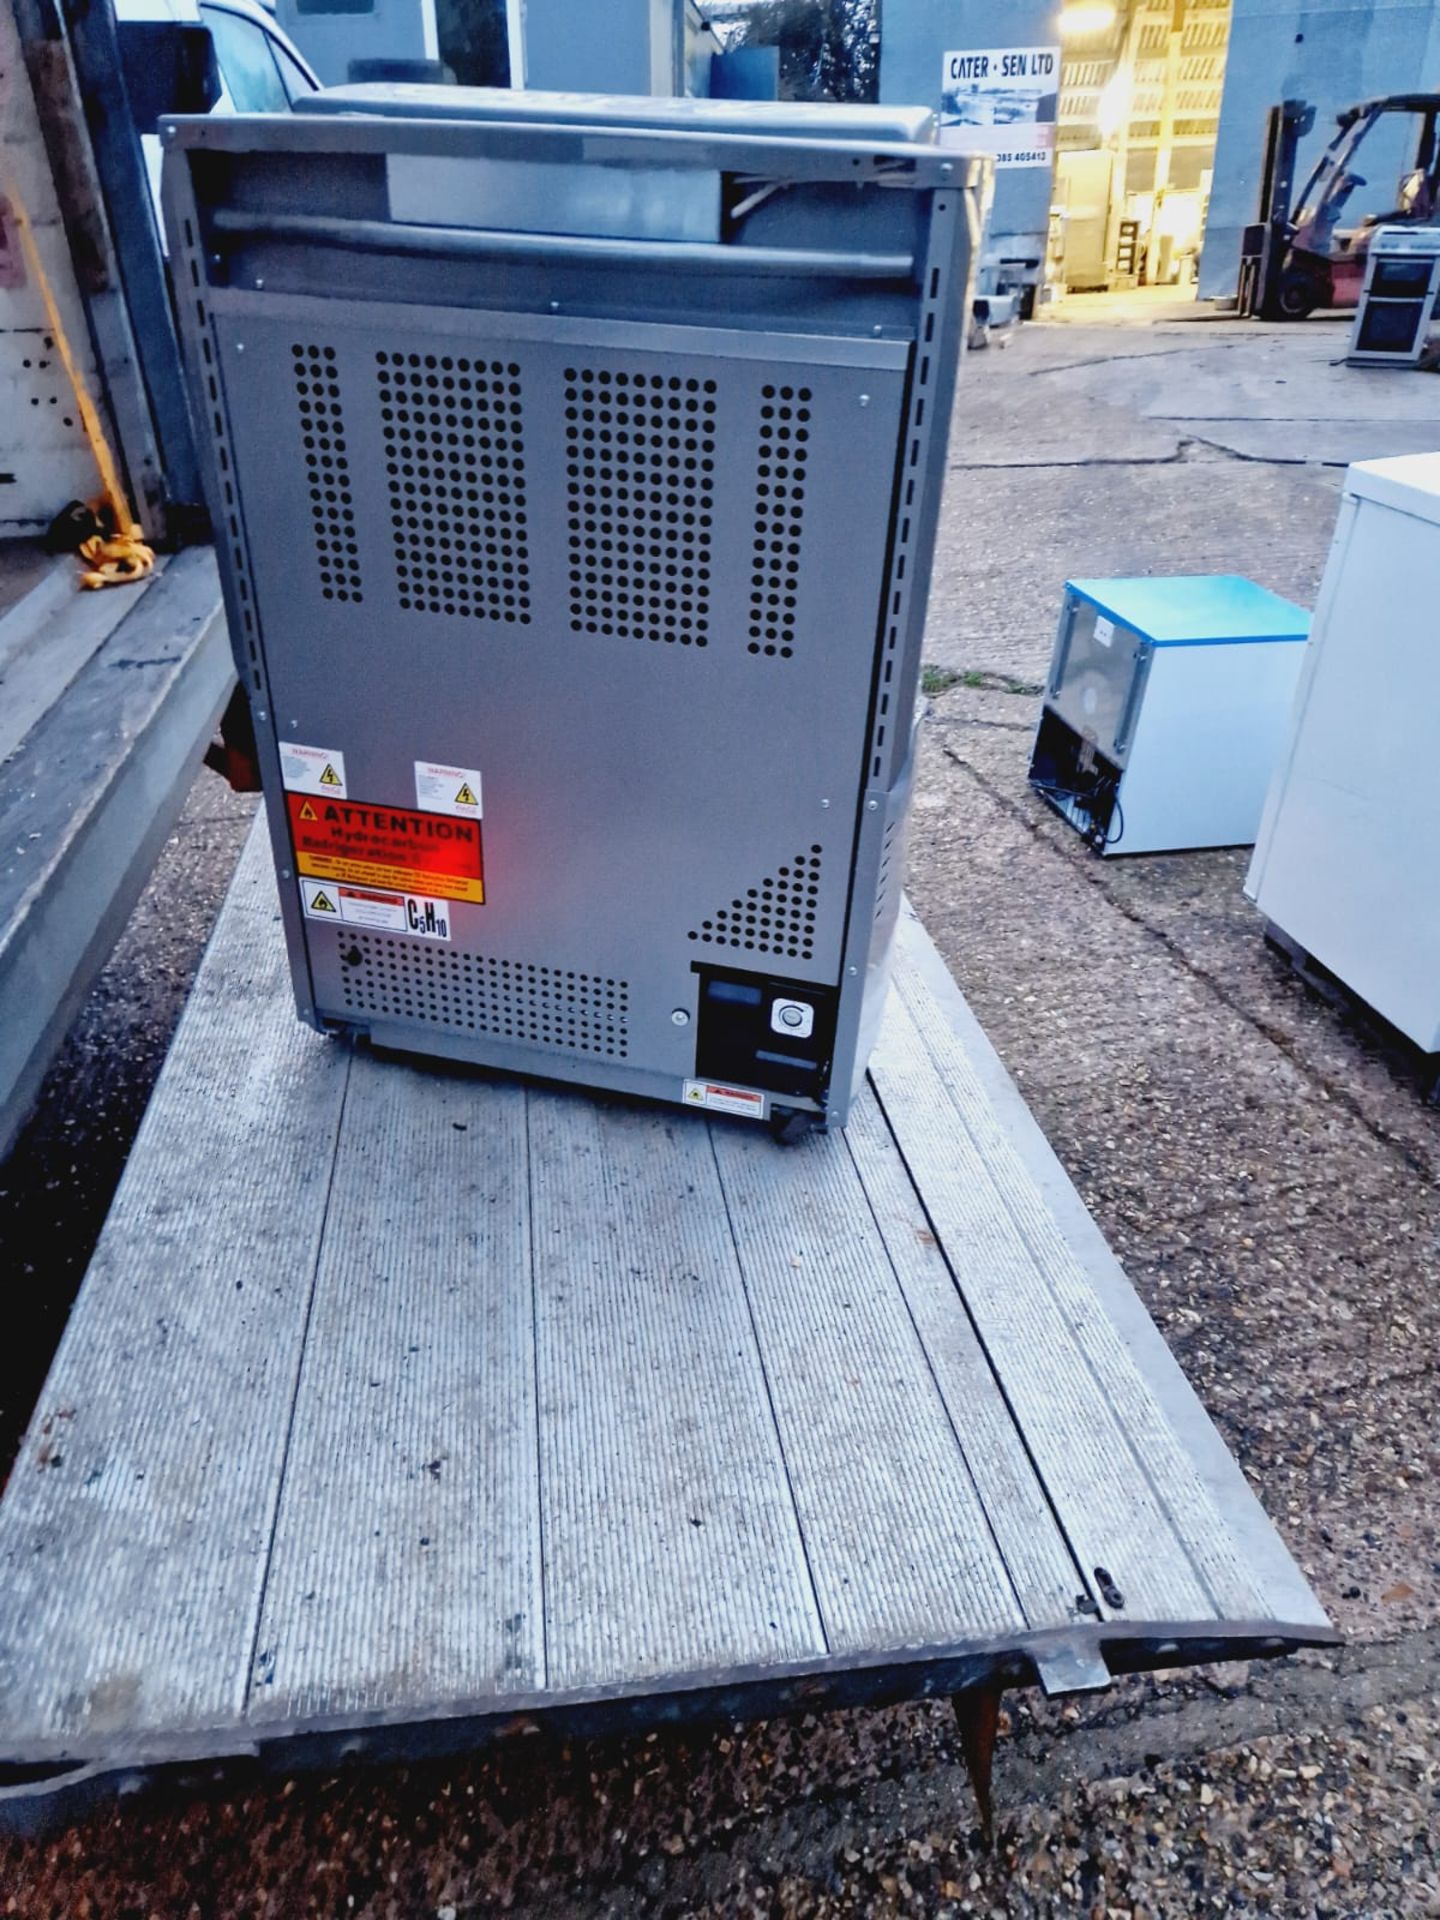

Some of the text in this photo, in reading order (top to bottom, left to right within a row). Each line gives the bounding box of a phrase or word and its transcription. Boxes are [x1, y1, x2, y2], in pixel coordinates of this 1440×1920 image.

[950, 56, 988, 79] CATER
[1001, 54, 1027, 77] SEN
[1031, 53, 1054, 75] LTD
[323, 804, 473, 843] ATTENTION
